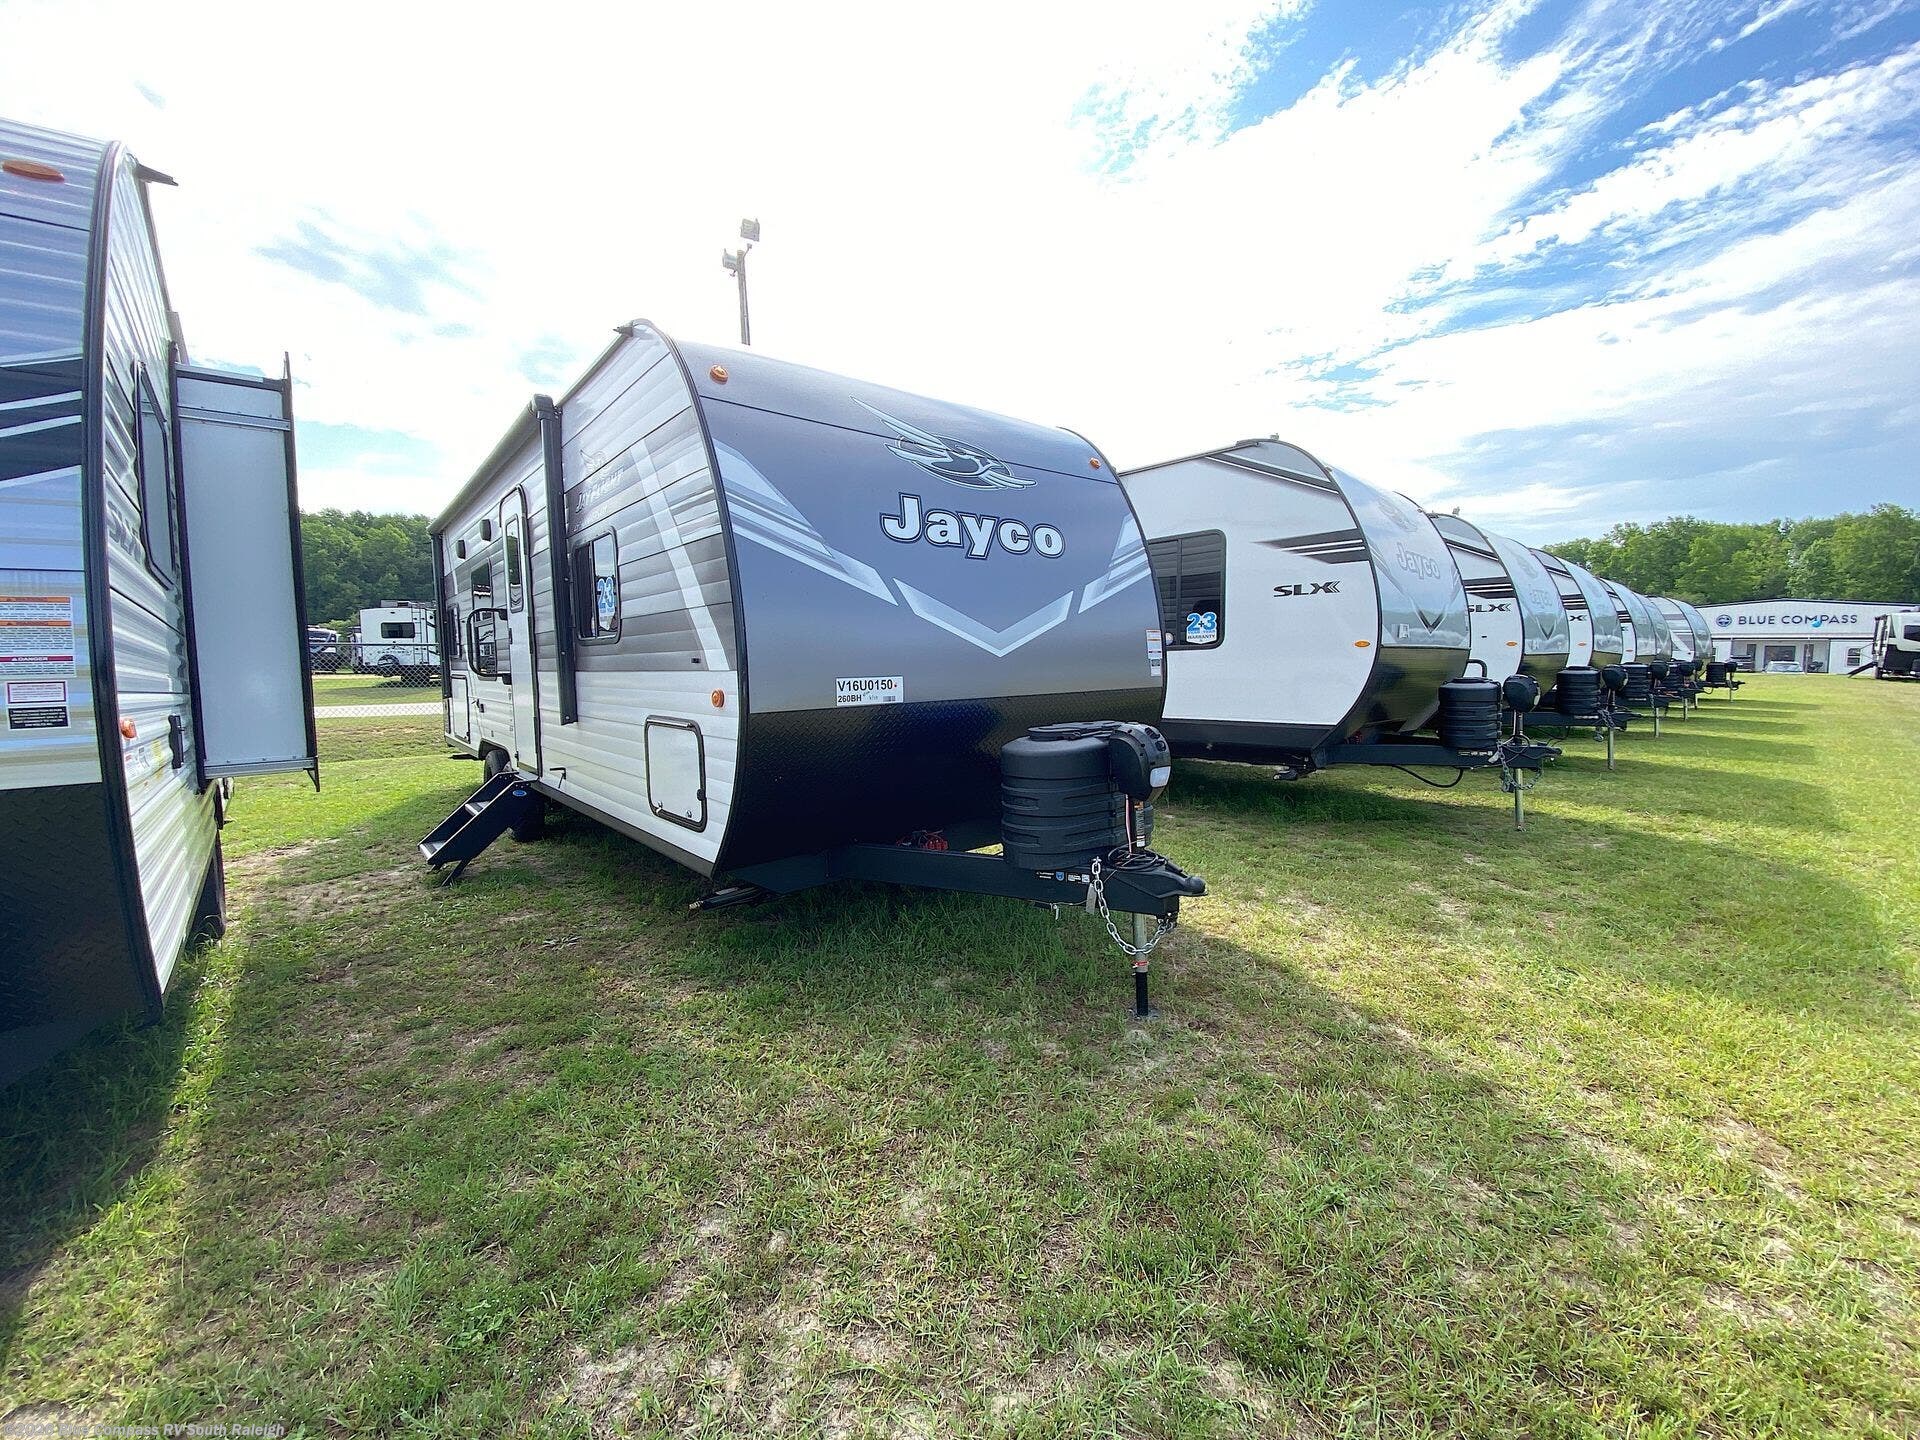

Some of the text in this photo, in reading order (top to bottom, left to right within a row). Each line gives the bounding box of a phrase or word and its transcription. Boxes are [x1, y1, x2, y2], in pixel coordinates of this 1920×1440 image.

[879, 492, 1066, 560] Jayco
[1396, 541, 1441, 580] Jayco
[1273, 580, 1341, 598] SLX
[1738, 614, 1858, 627] BLUE COMPASS
[837, 679, 893, 692] V16U0150
[838, 694, 862, 703] 260BH
